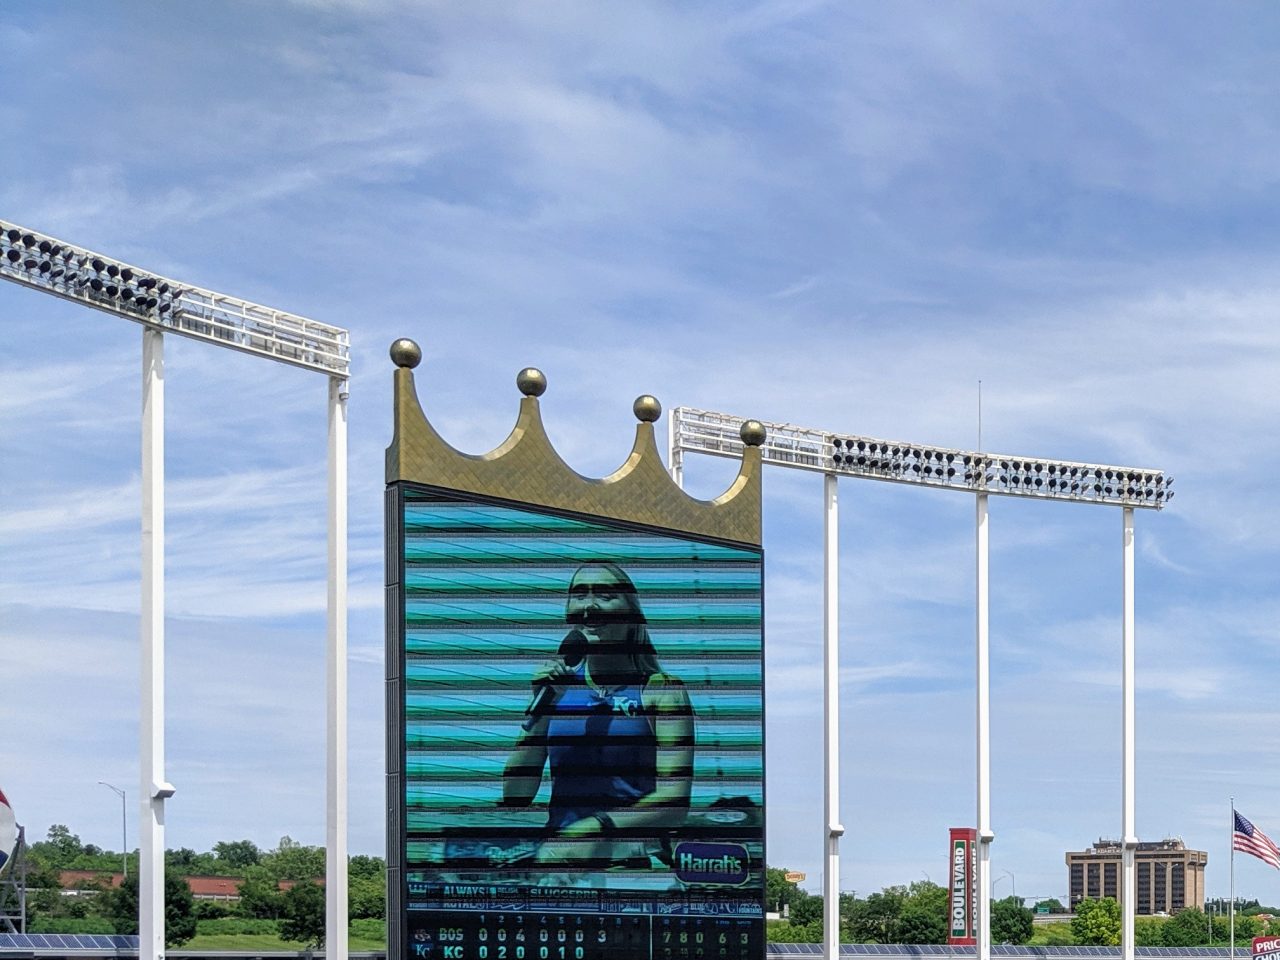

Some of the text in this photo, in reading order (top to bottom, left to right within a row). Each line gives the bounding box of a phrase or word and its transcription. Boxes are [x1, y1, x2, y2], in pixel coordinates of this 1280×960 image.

[953, 847, 965, 930] BOULEVARD
[440, 928, 464, 941] BOS
[479, 929, 487, 941] 0
[498, 929, 506, 941] 0
[516, 929, 525, 941] 4
[539, 930, 548, 941] 0
[558, 930, 566, 942] 0
[576, 931, 583, 942] 0
[598, 931, 606, 943] 3
[663, 932, 671, 943] 7
[696, 932, 703, 944] 0
[719, 933, 727, 944] 6
[741, 933, 748, 945] 3
[444, 946, 463, 958] KC
[479, 946, 487, 958] 0
[498, 946, 506, 958] 2
[516, 946, 525, 958] 0
[540, 946, 548, 959] 0
[559, 946, 565, 959] 1
[576, 947, 583, 959] 0
